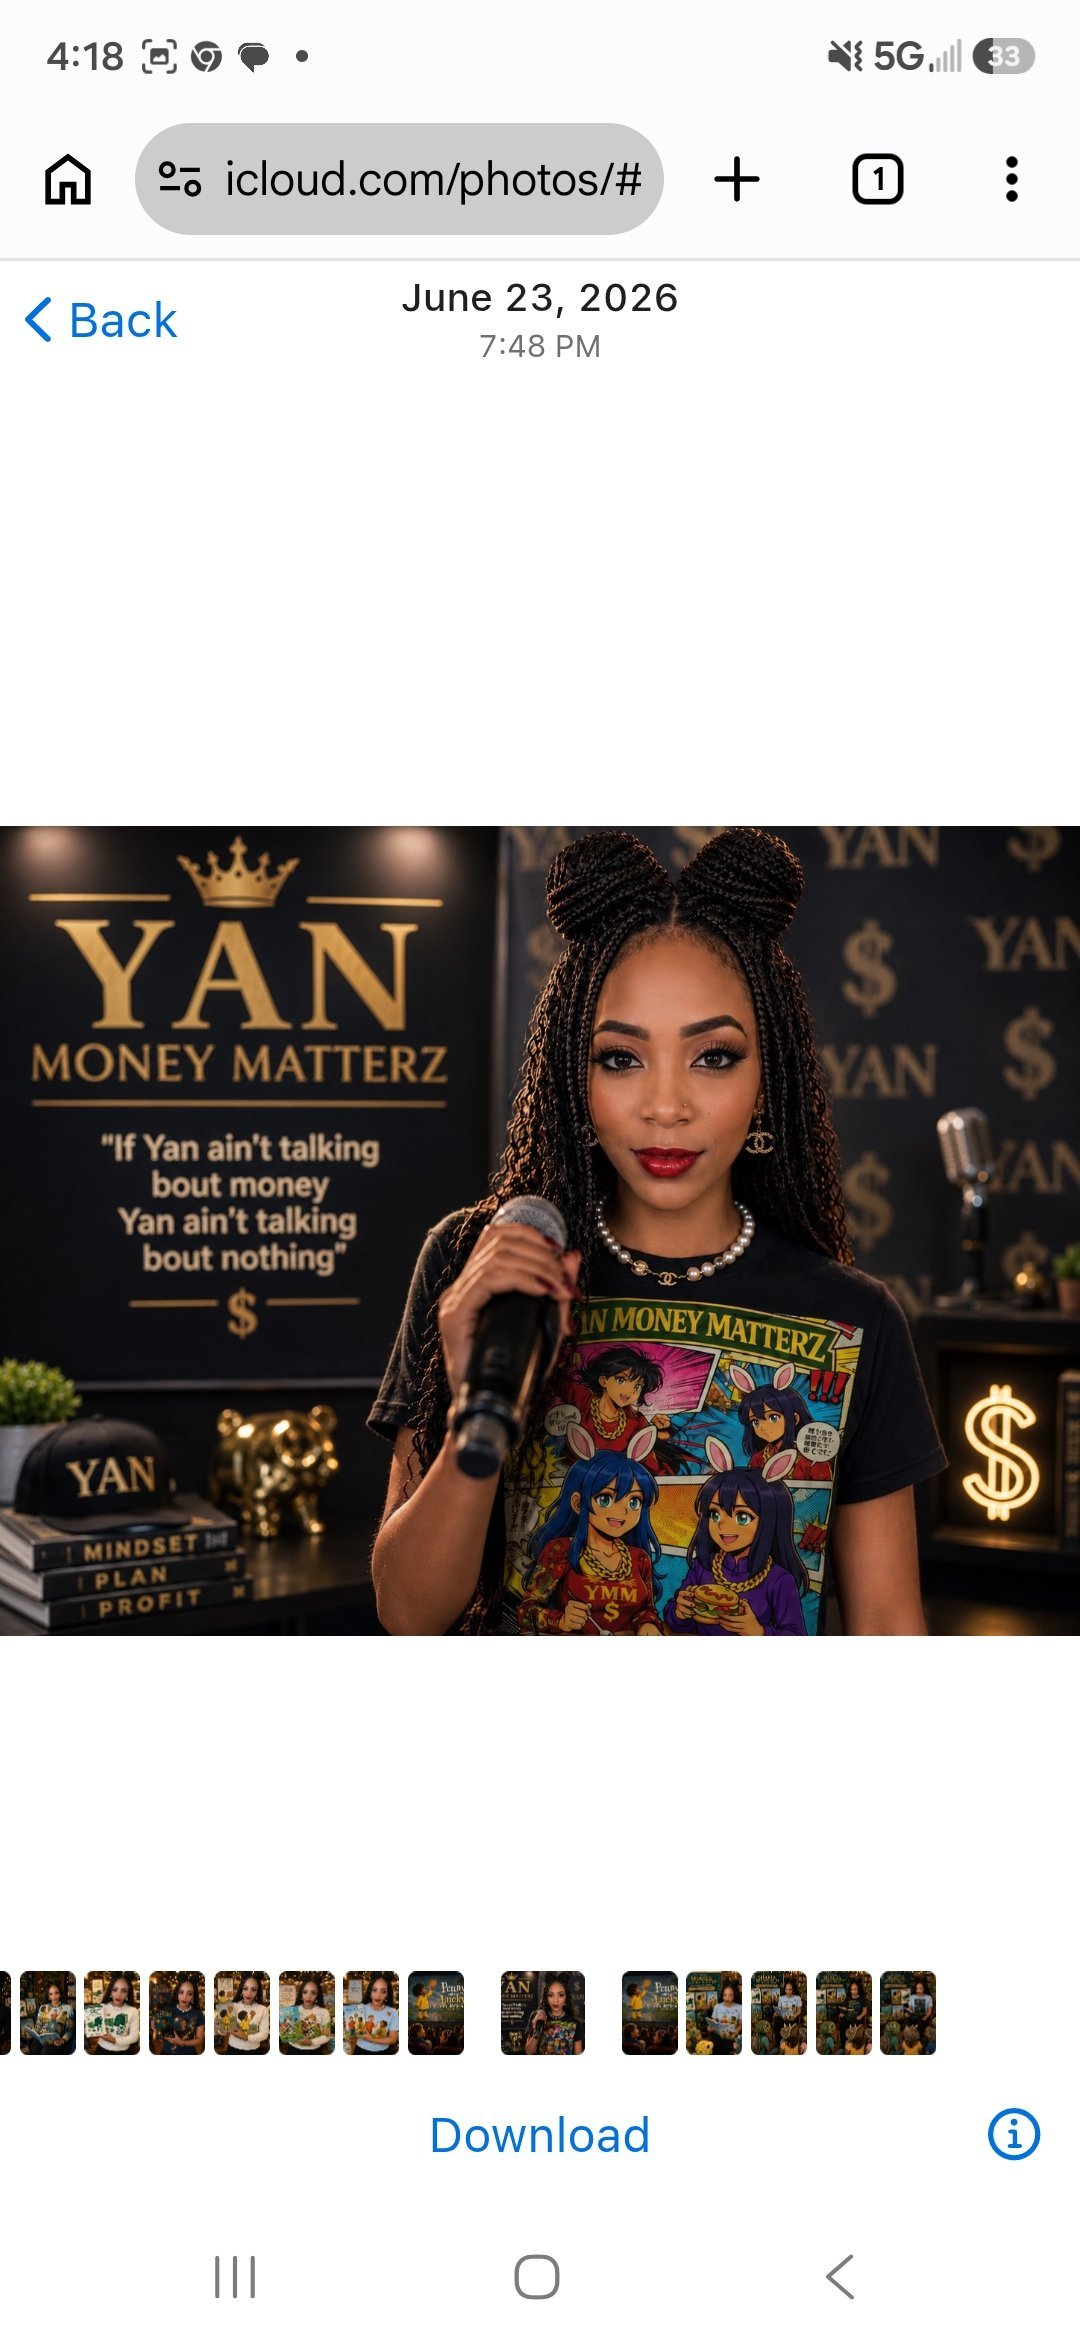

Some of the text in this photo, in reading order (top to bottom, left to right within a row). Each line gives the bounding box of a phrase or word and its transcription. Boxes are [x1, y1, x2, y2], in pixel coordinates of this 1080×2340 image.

[46, 41, 124, 72] 4:18
[873, 40, 925, 71] 5G
[987, 44, 1020, 68] 33
[225, 160, 643, 207] icloud.com/photos/#
[872, 166, 884, 191] 1
[401, 282, 679, 319] June 23, 2026
[70, 300, 178, 339] Back
[479, 333, 601, 358] 7:48 PM
[816, 826, 941, 870] YAN
[54, 918, 419, 1031] YAN
[31, 1042, 448, 1083] MONEY MATTERZ
[820, 1043, 938, 1099] YAN
[101, 1133, 137, 1162] "If
[143, 1134, 199, 1162] Yan
[279, 1133, 381, 1168] talking
[152, 1170, 330, 1204] bout money
[118, 1207, 177, 1235] Yan
[255, 1206, 358, 1241] talking
[142, 1243, 348, 1277] bout nothing"
[613, 1306, 705, 1337] MONEY
[707, 1311, 828, 1364] MATTERZ
[963, 1384, 1040, 1522] $
[66, 1456, 156, 1498] YAN
[83, 1532, 200, 1563] MINDSET
[94, 1564, 168, 1591] PLAN
[584, 1585, 638, 1604] YMM
[99, 1587, 201, 1618] PROFIT
[431, 2115, 650, 2154] Download
